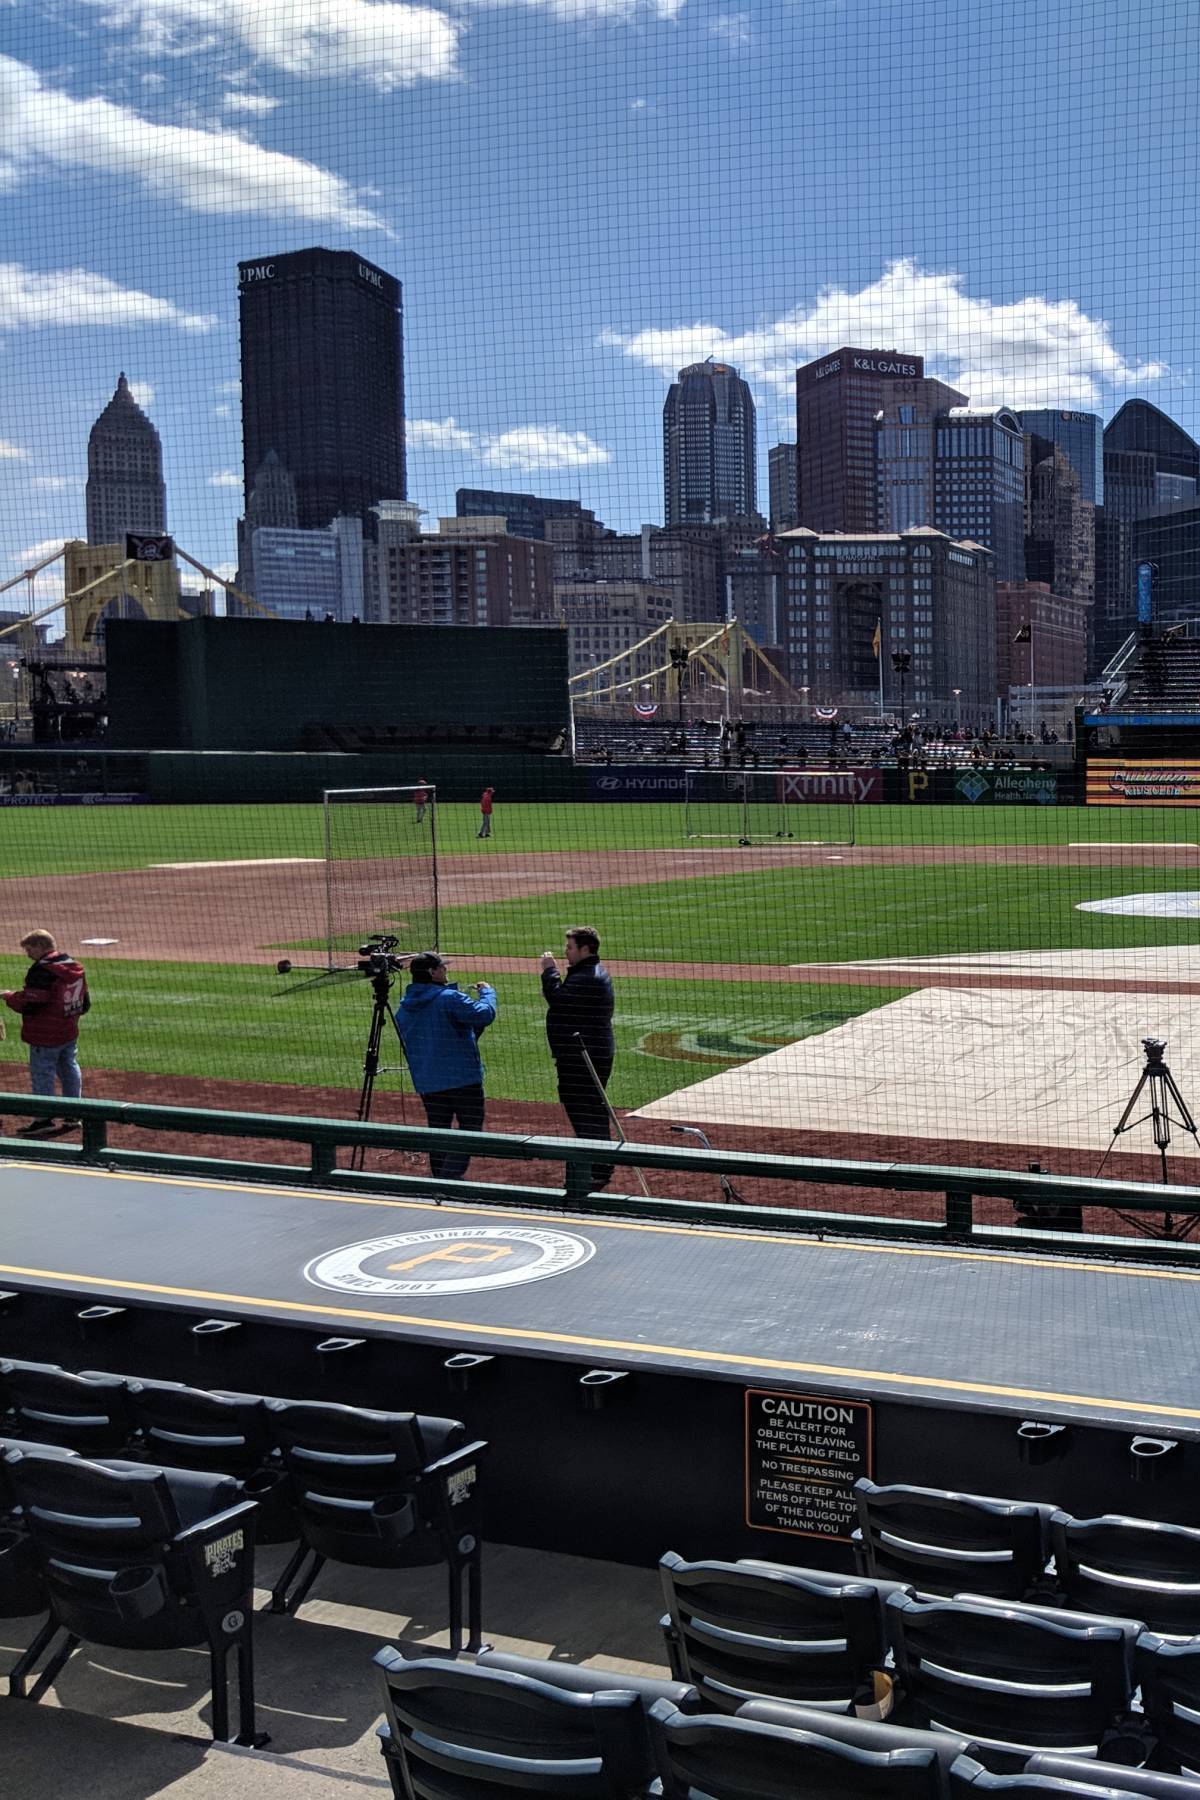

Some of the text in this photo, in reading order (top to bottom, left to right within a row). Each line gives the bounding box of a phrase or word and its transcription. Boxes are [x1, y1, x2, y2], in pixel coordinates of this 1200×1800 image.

[239, 264, 275, 283] UPMC
[358, 263, 384, 289] UPMC
[878, 361, 916, 376] GATES
[625, 778, 694, 790] HYUNDAI
[907, 771, 929, 800] P
[994, 777, 1057, 791] Allegheny
[360, 1228, 576, 1271] PITTSBURGH PIRATES BASEBALL
[386, 1242, 513, 1272] P
[332, 1273, 384, 1289] SINCE
[761, 1398, 854, 1424] CAUTION
[769, 1418, 846, 1436] BE ALERT FOR
[757, 1428, 855, 1449] OBJECTS LEAVING
[756, 1440, 860, 1462] THE PLAYING FIELD
[762, 1460, 854, 1480] NO TRESPASSING
[757, 1490, 788, 1502] ITEMS
[790, 1495, 812, 1505] OFF
[814, 1498, 836, 1509] THE
[760, 1479, 856, 1500] PLEASE KEEP ALL
[765, 1503, 852, 1523] OF THE DUGOUT
[777, 1516, 839, 1533] THANK YOU
[205, 1528, 244, 1566] PIRATES
